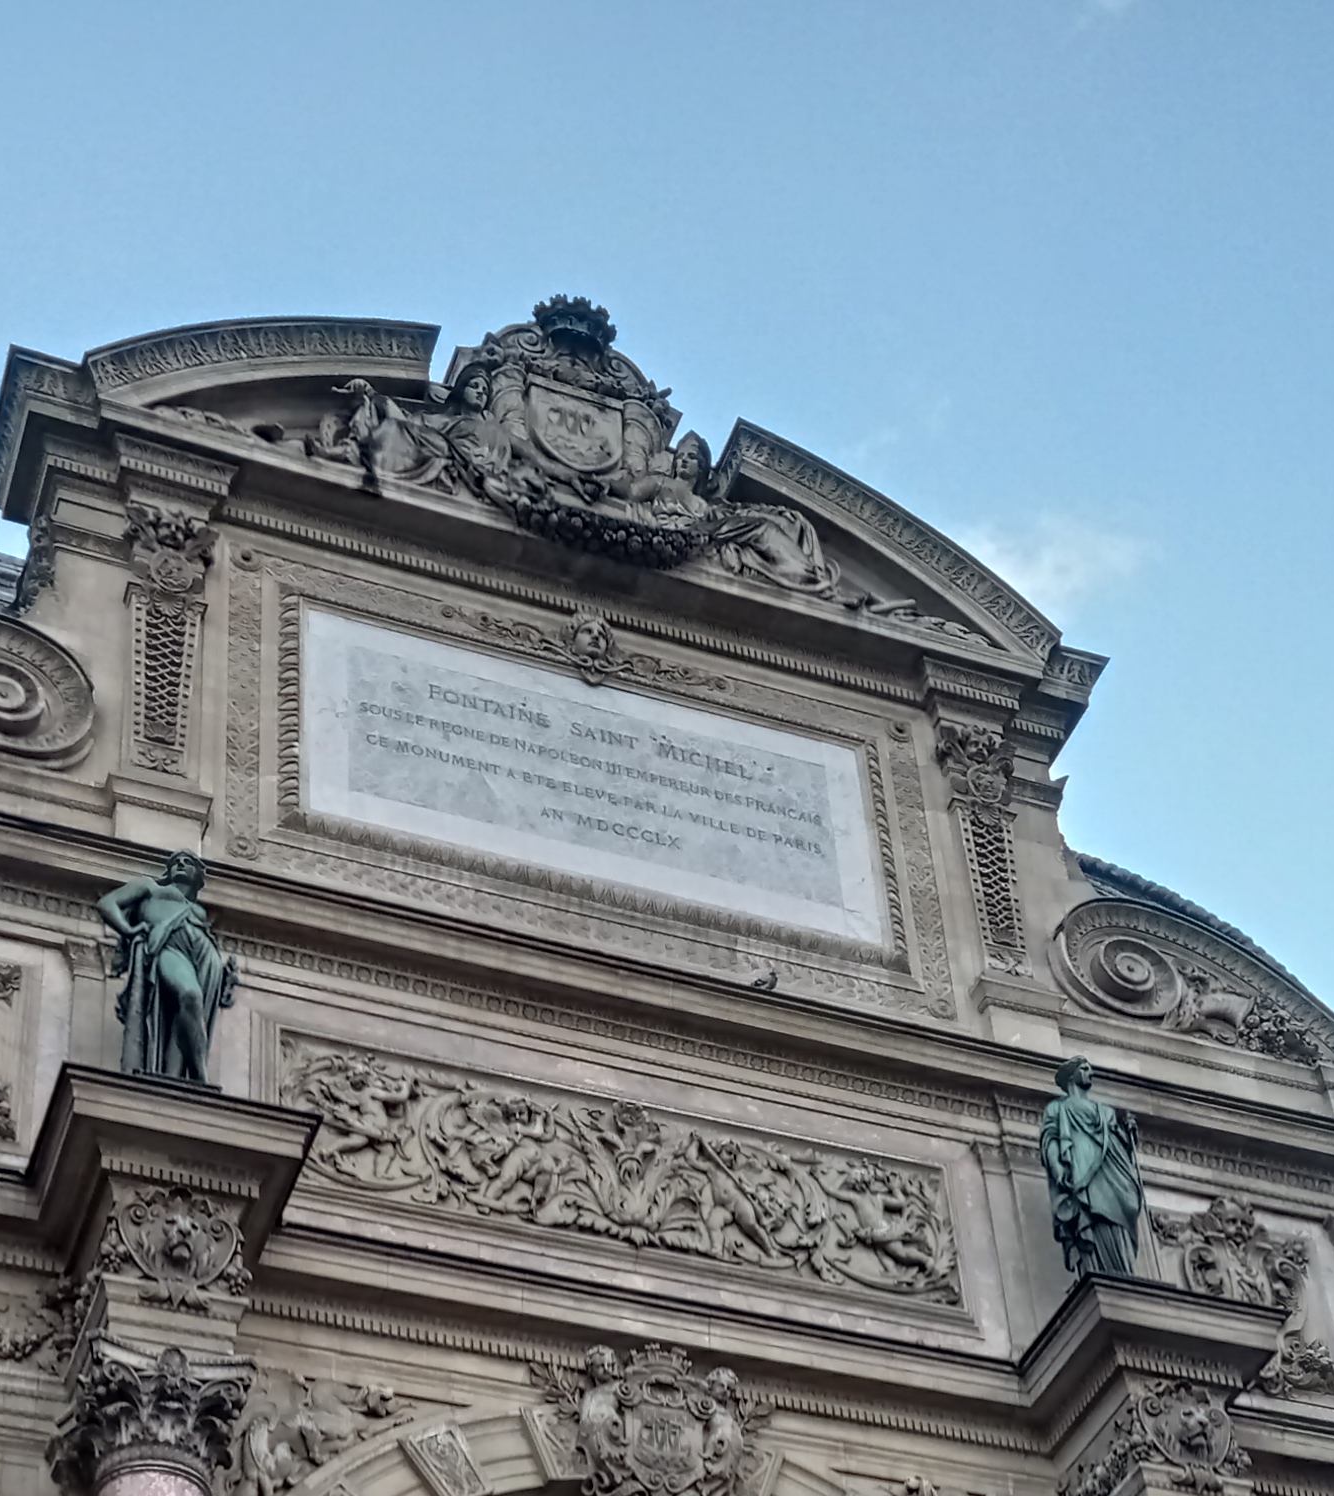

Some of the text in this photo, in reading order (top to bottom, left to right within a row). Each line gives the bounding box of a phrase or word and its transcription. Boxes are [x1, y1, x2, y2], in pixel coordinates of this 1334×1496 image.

[359, 701, 403, 720] SOUS
[406, 713, 425, 727] LE
[489, 733, 510, 748] DE
[624, 766, 711, 798] EMPEREUR
[715, 790, 742, 804] DES
[428, 683, 754, 781] FONTAINE SAINT MICHEL
[366, 733, 388, 748] CE
[396, 740, 501, 776] MONUMENT
[506, 768, 517, 779] A
[662, 805, 683, 820] LA
[689, 811, 740, 835] VILLE
[746, 826, 767, 841] DE
[540, 807, 564, 822] AN
